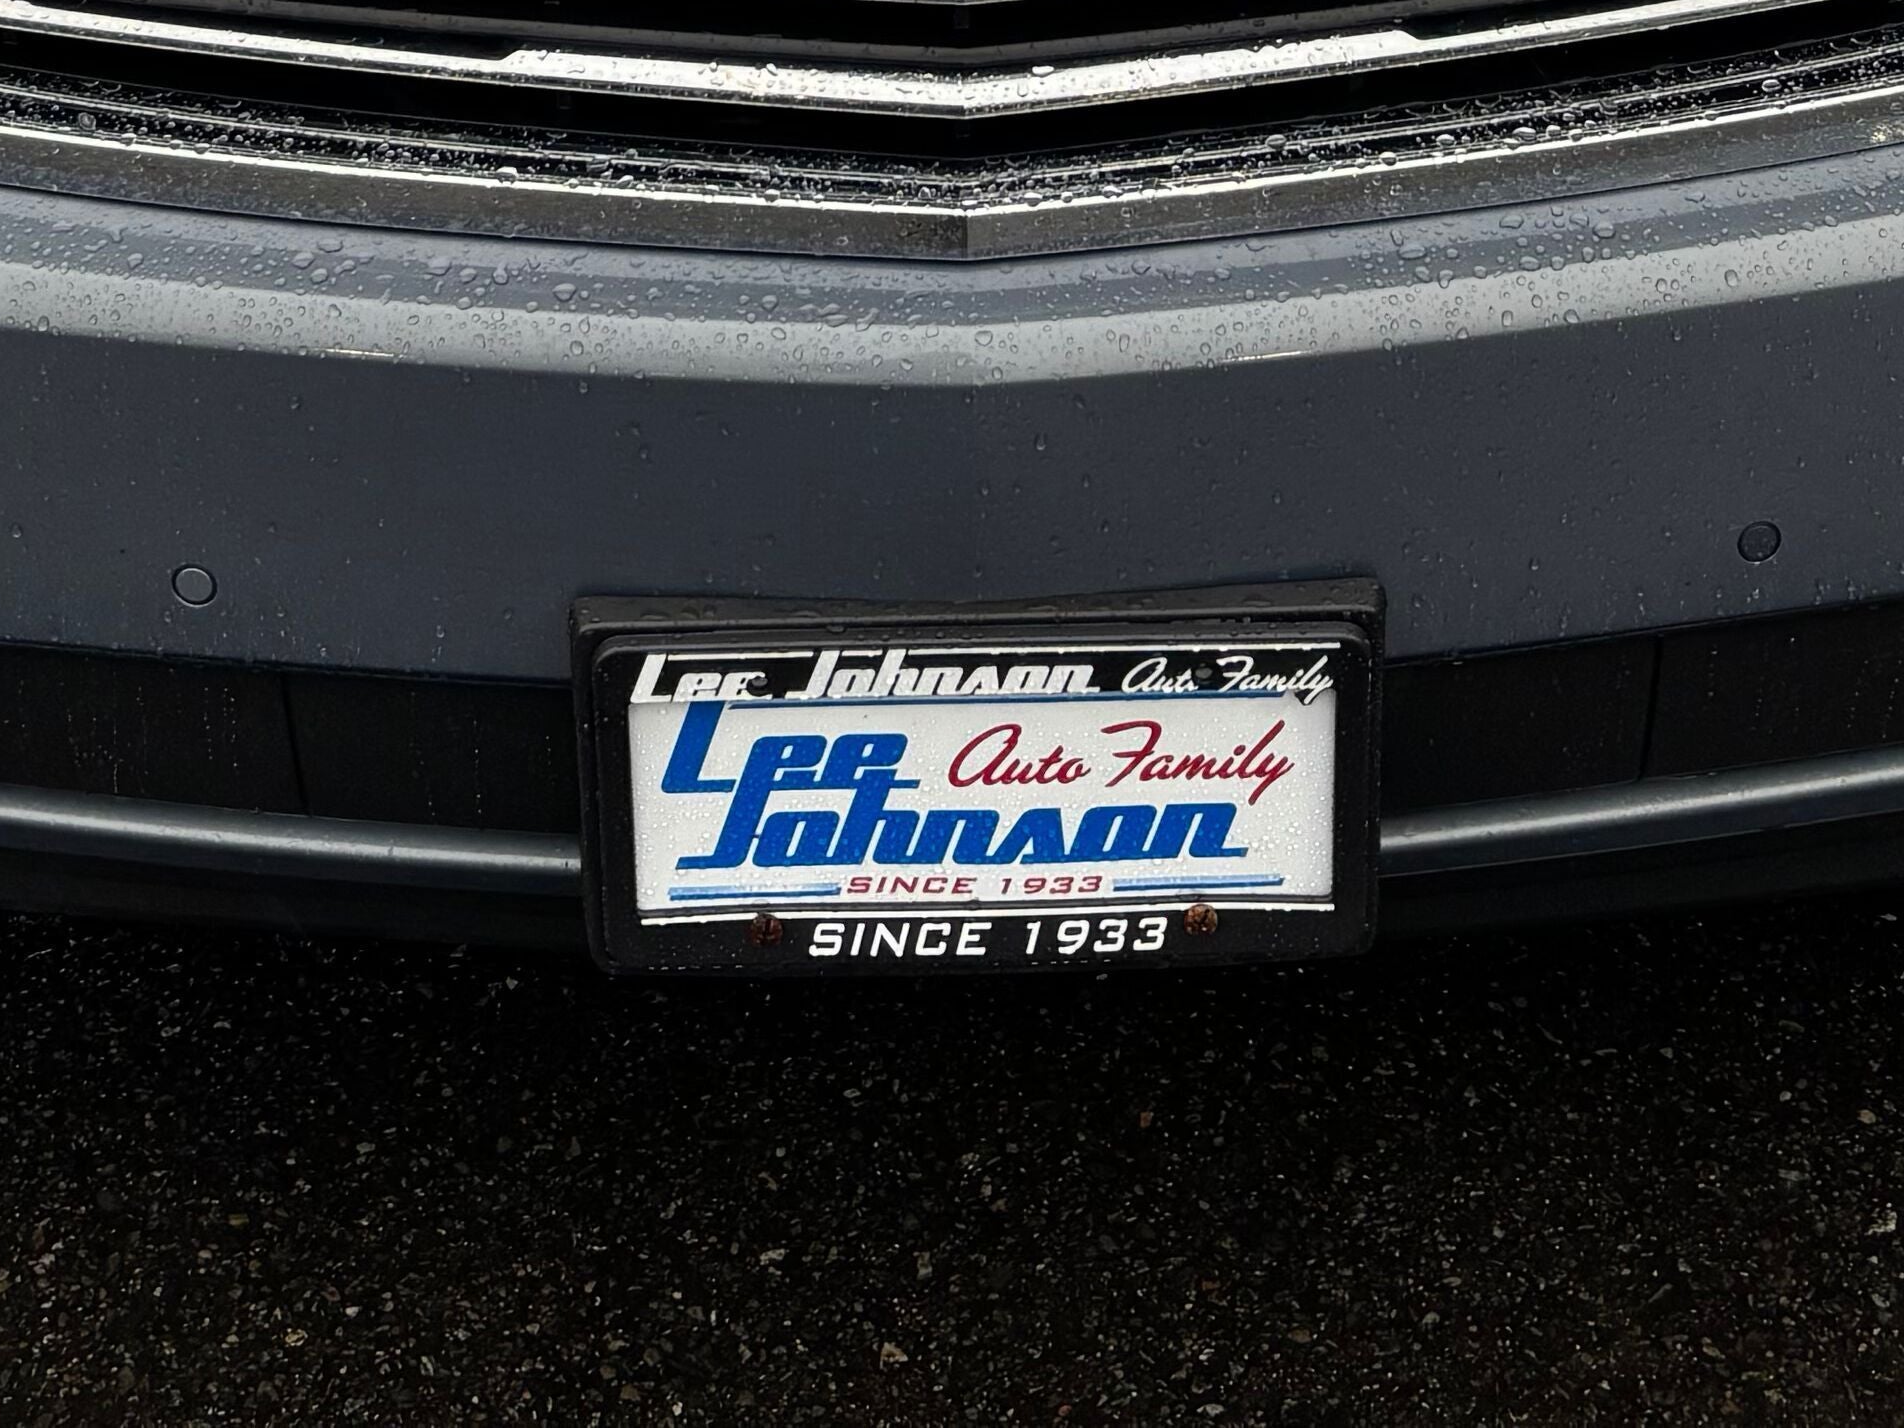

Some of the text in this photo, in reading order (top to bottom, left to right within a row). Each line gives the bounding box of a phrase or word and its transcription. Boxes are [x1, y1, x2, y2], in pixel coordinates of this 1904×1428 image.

[630, 653, 773, 703] Lee
[784, 649, 1101, 699] Johnson
[1216, 654, 1334, 705] Family
[661, 701, 1296, 806] Lee Auto Family
[675, 774, 1249, 870] Johnson
[846, 874, 1104, 896] SINCE 1933
[807, 915, 1169, 958] SINCE 1933
